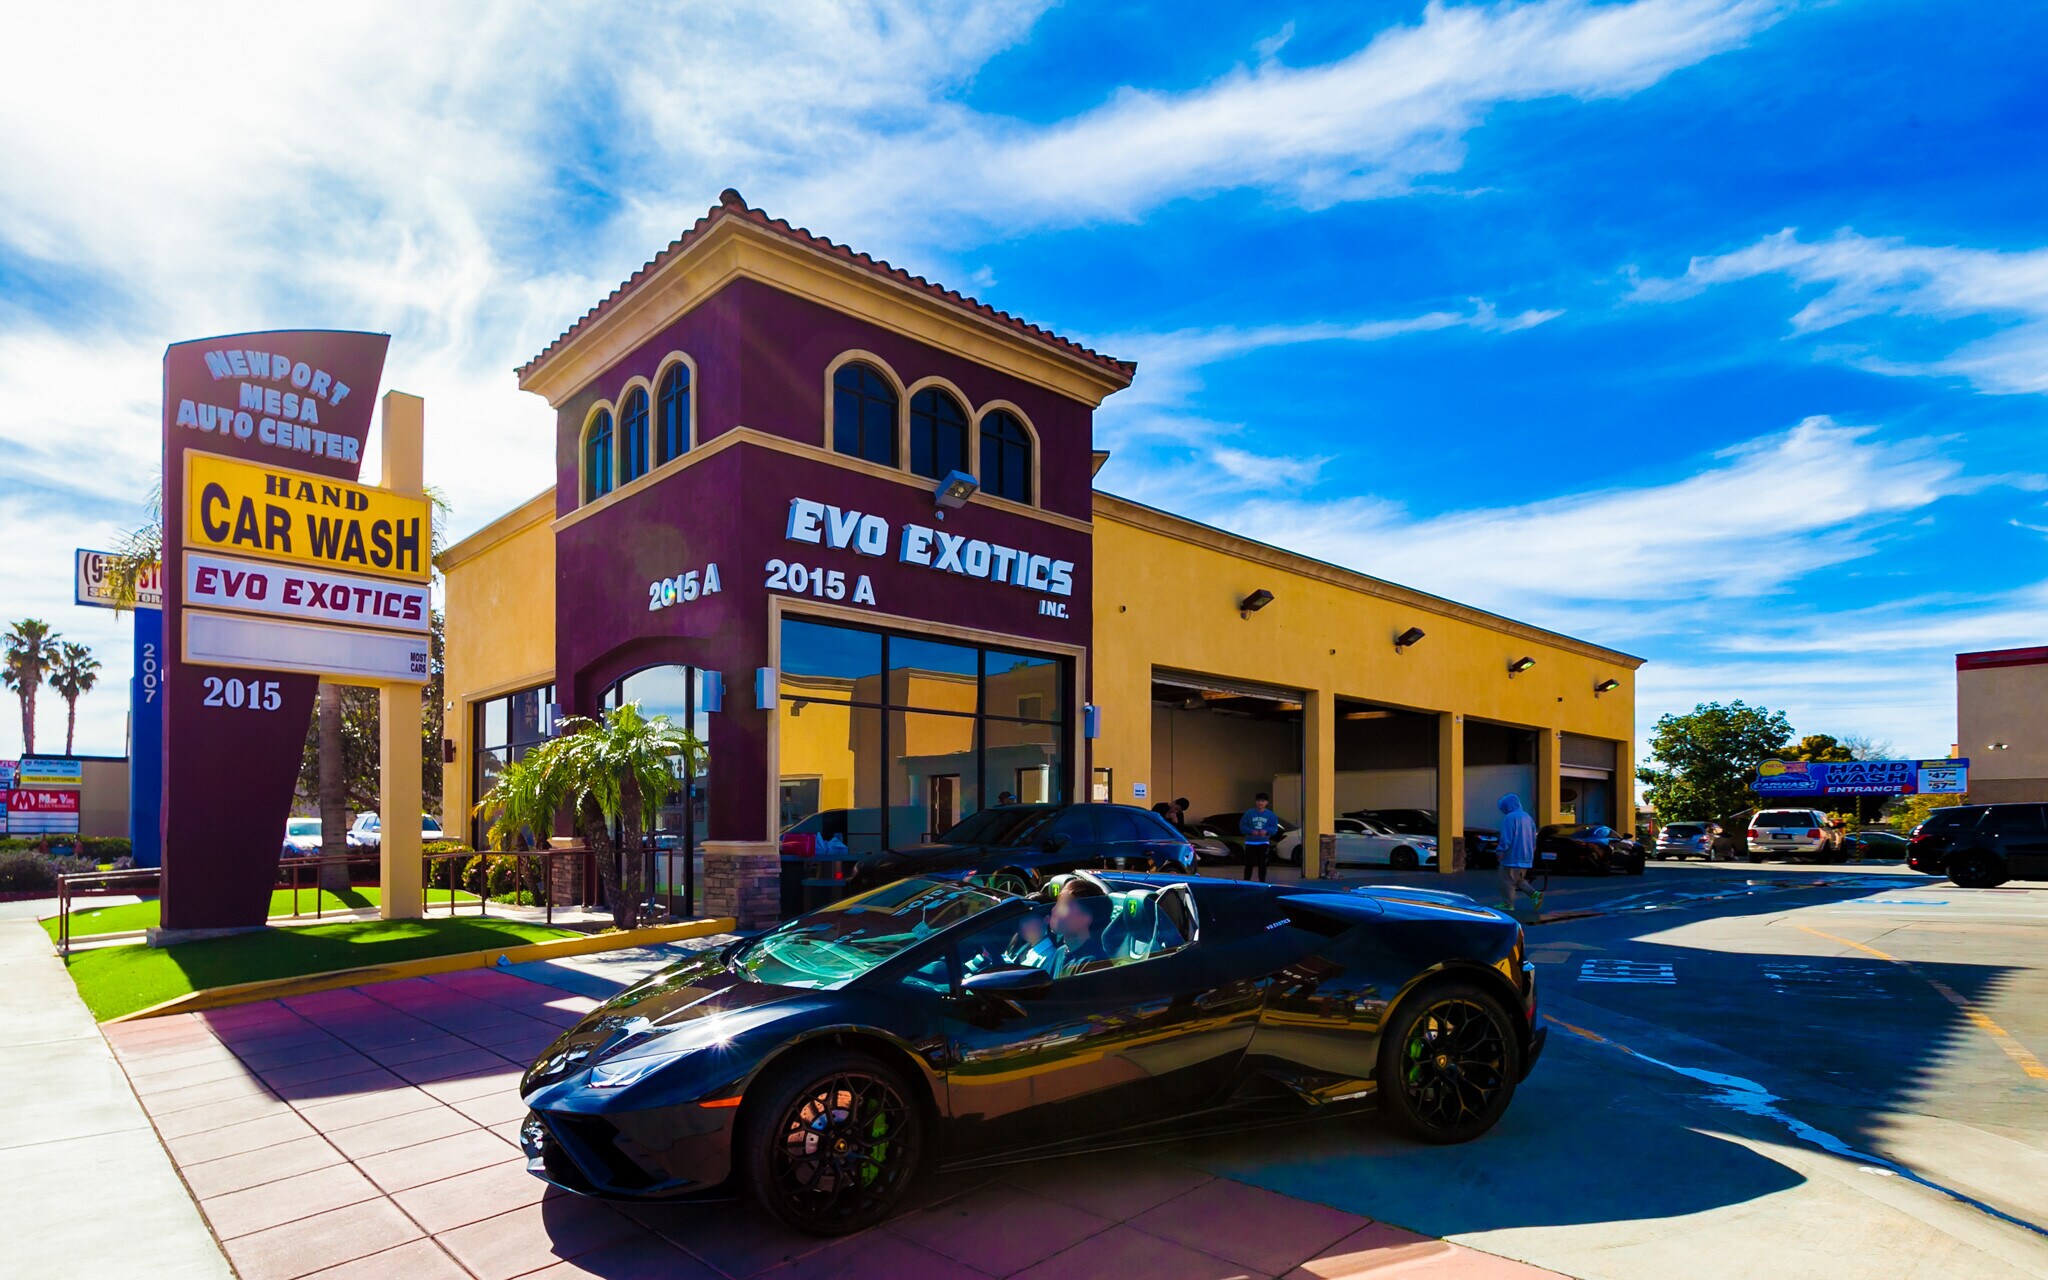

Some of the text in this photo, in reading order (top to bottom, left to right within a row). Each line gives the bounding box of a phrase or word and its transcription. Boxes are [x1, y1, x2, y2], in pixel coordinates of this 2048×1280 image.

[204, 349, 351, 408] NEWPORT
[239, 382, 319, 425] MESA
[176, 398, 360, 464] AUTO CENTER
[264, 473, 369, 511] HAND
[200, 481, 420, 573] CAR WASH
[785, 497, 1075, 596] EVO EXOTICS
[195, 566, 423, 621] EVO EXOTICS
[648, 562, 721, 611] 2015 A
[765, 558, 876, 606] 2015 A
[1038, 599, 1069, 619] INC.
[143, 642, 156, 704] 2007
[410, 652, 427, 663] MOST
[410, 662, 427, 674] CARS
[202, 676, 282, 711] 2015
[1825, 772, 1908, 785] WASH
[1828, 785, 1903, 793] ENTRANCE
[1829, 762, 1909, 774] HAND
